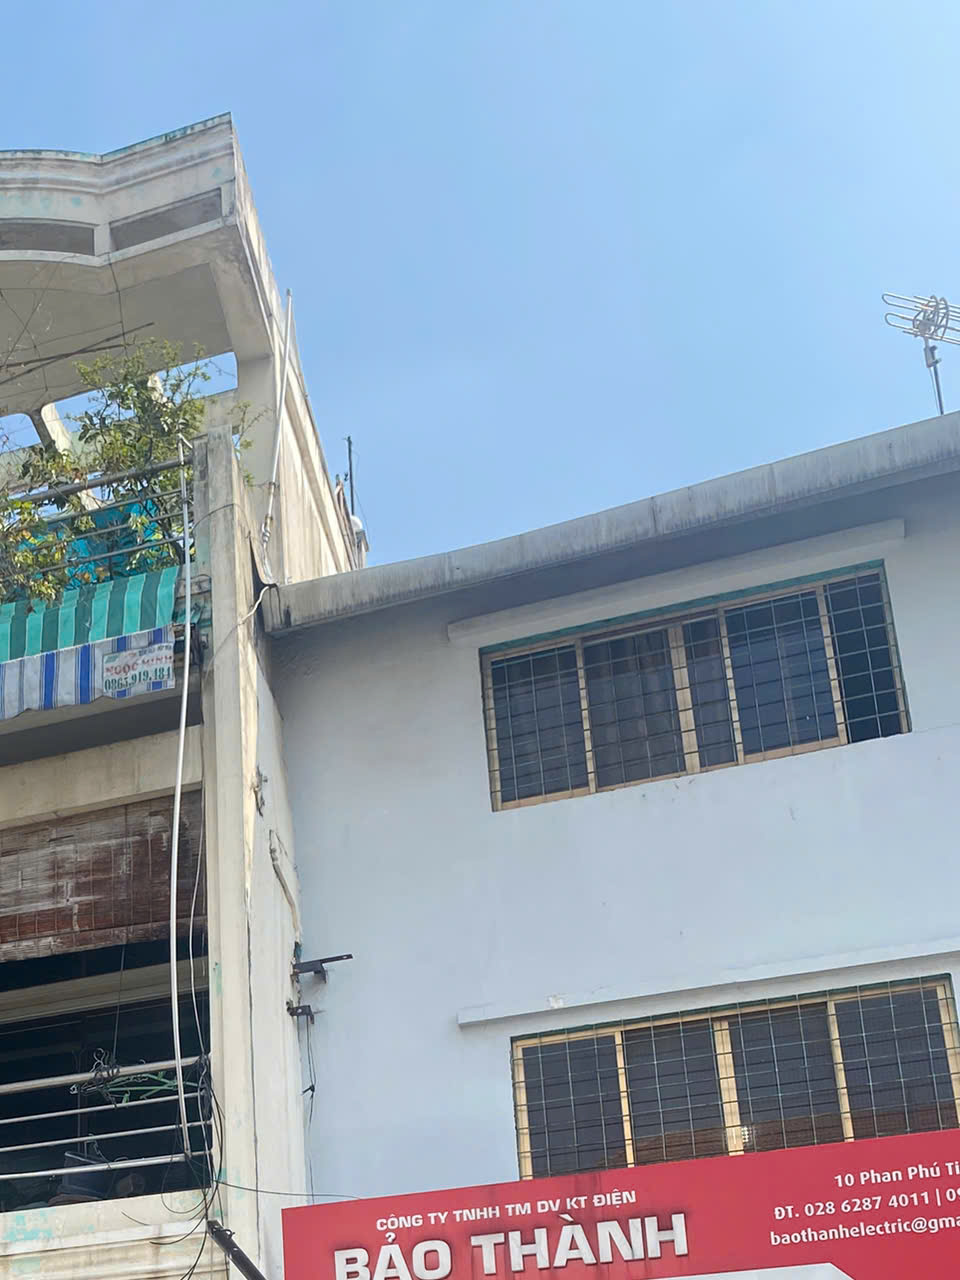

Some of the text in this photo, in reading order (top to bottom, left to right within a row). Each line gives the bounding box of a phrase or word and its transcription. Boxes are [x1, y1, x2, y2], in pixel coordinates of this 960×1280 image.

[834, 1174, 855, 1187] 10
[859, 1169, 902, 1185] Phan
[907, 1162, 940, 1180] Phú
[376, 1188, 636, 1231] CÔNG TY TNHH TM DV KT ĐIỆN
[774, 1206, 799, 1220] ĐT.
[804, 1201, 836, 1217] 028
[841, 1196, 882, 1213] 6287
[888, 1191, 929, 1208] 4011
[470, 1213, 689, 1276] THÀNH
